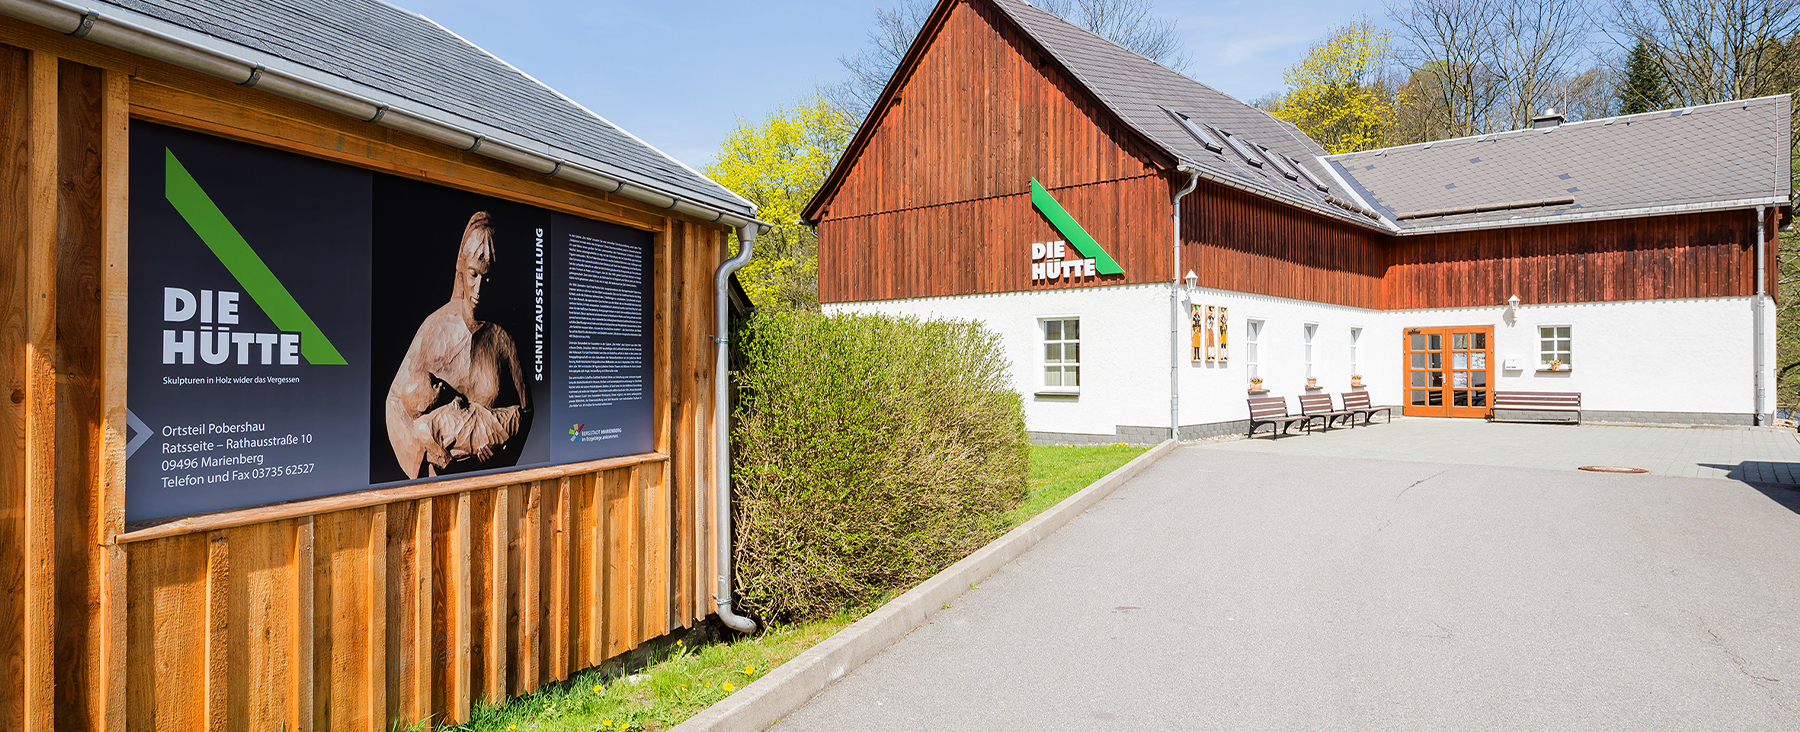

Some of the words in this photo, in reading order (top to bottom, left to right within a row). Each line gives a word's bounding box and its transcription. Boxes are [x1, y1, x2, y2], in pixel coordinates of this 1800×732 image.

[1032, 240, 1065, 260] DIE
[1032, 258, 1096, 280] HÜTTE
[164, 287, 240, 325] DIE
[535, 227, 544, 382] SCHNITZAUSSTELLUNG
[163, 325, 299, 365] HÜTTE
[162, 376, 205, 386] Skulpturen
[206, 376, 214, 385] in
[215, 376, 232, 385] Holz
[232, 376, 253, 384] wider
[253, 376, 267, 384] das
[267, 376, 300, 385] Vergessen
[162, 423, 205, 437] Ortsteil
[208, 421, 265, 434] Pobershau
[162, 441, 214, 454] Ratsseite
[226, 434, 299, 449] Rathausstraße
[301, 433, 313, 444] 10
[161, 457, 199, 471] 09496
[201, 453, 264, 468] Marienberg
[161, 474, 204, 488] Telefon
[207, 471, 229, 484] und
[232, 470, 250, 481] Fax
[252, 466, 283, 479] 03735
[285, 463, 315, 476] 62527
